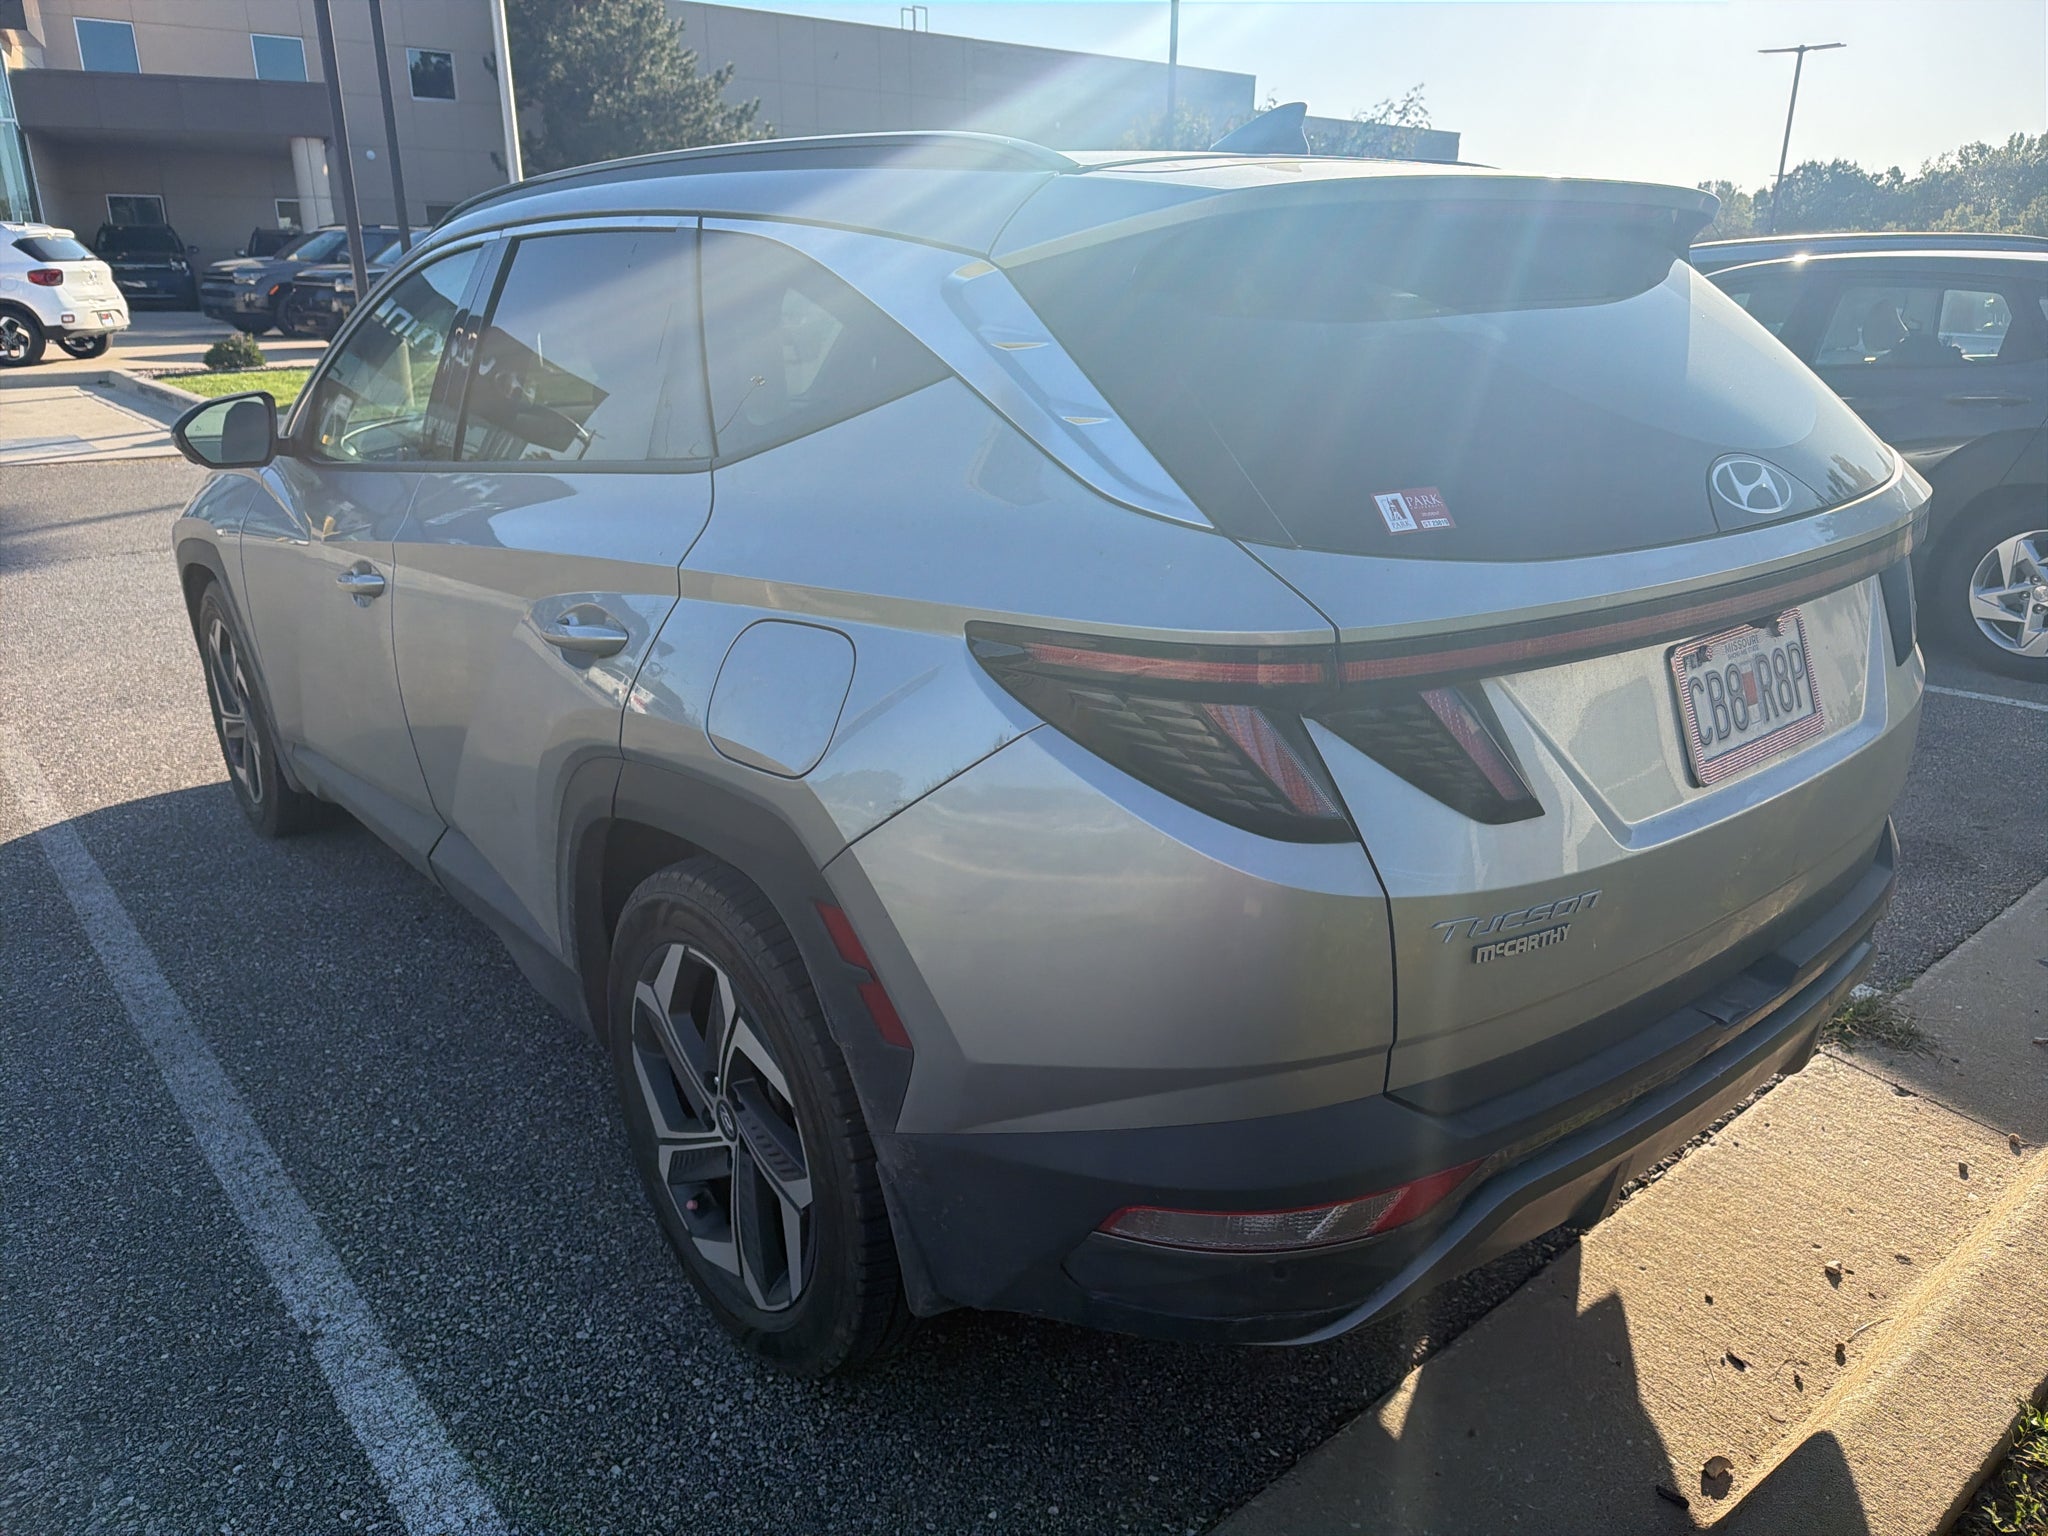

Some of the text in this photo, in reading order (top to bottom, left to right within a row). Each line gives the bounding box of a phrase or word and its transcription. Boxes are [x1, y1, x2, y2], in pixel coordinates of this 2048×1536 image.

[1405, 494, 1442, 507] PARK
[1724, 634, 1760, 653] MISSOURI
[1688, 641, 1804, 746] CB8 R8P
[1432, 889, 1602, 943] TUCSON
